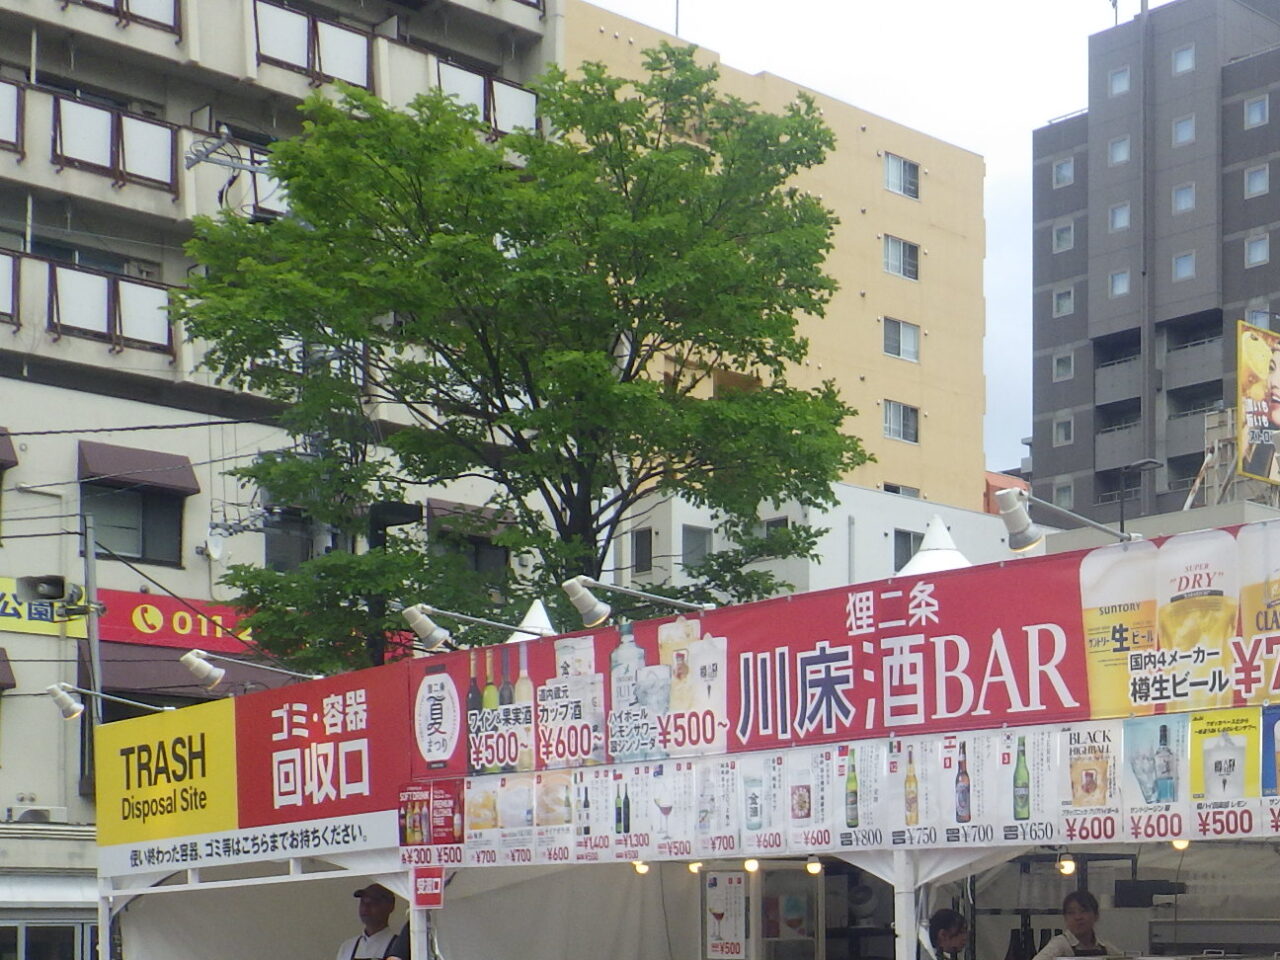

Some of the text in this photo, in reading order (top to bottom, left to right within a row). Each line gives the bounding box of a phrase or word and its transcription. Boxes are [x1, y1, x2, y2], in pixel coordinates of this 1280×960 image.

[846, 581, 939, 636] 狸二条
[1100, 602, 1141, 616] SUNTORY
[1112, 623, 1131, 652] 生
[1132, 630, 1153, 645] ビール
[1130, 647, 1220, 671] 国内4メーカー
[1131, 670, 1229, 703] 樽生ビール
[272, 689, 367, 741] ゴミ・容器
[427, 695, 447, 737] 夏
[539, 700, 582, 723] カップ酒
[610, 723, 657, 738] レモンサワー
[1069, 730, 1112, 745] BLACK
[120, 733, 206, 790] TRASH
[272, 738, 370, 809] 回収口
[122, 786, 207, 823] Disposal Site
[962, 824, 993, 842] ¥700
[1020, 822, 1053, 840] ¥650
[1066, 816, 1115, 841] ¥600
[1130, 813, 1182, 839] ¥600
[1198, 809, 1252, 836] ¥500
[711, 835, 735, 850] ¥700
[757, 833, 781, 848] ¥600
[804, 829, 830, 845] ¥600
[853, 829, 882, 845] ¥800
[907, 827, 937, 845] ¥750
[437, 847, 462, 863] ¥500
[667, 841, 691, 855] ¥500
